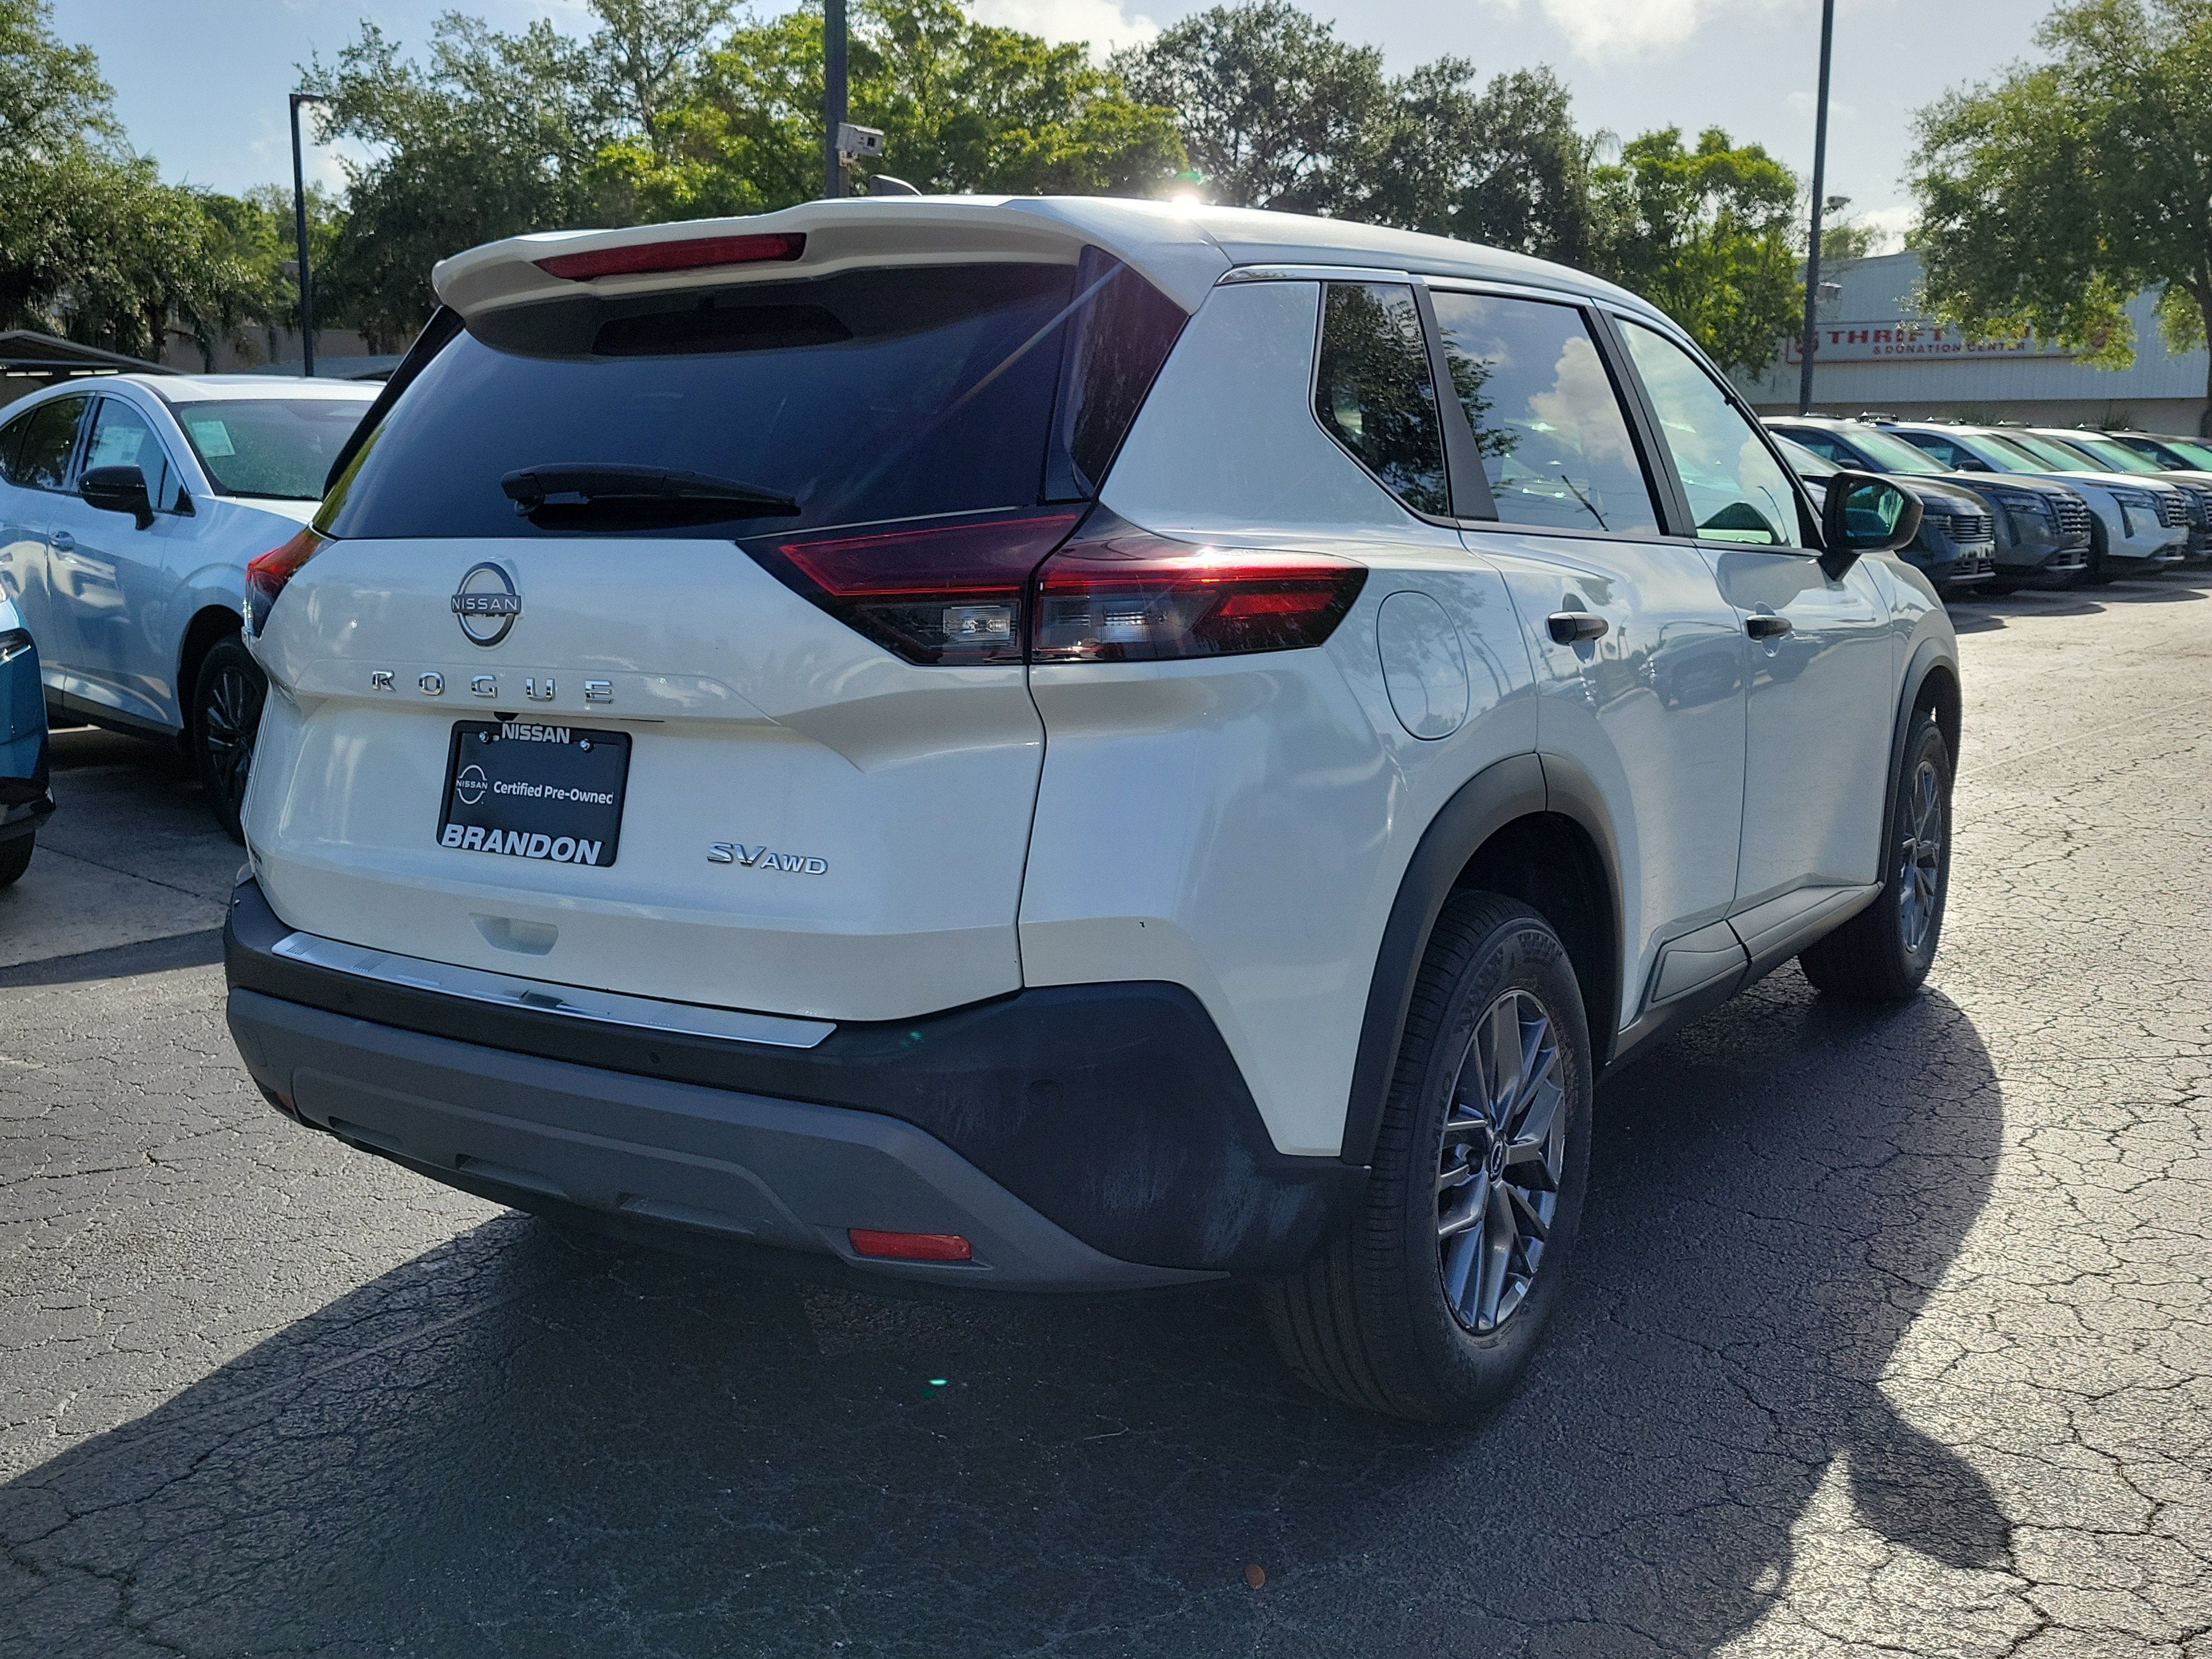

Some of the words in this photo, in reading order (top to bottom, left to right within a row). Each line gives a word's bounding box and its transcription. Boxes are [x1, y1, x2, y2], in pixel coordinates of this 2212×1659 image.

[1827, 329, 1945, 343] THRIFT
[1874, 345, 1881, 354] &
[1884, 343, 1961, 354] DONATION
[452, 598, 517, 610] NISSAN
[372, 669, 614, 704] ROGUE
[501, 723, 570, 744] NISSAN
[456, 780, 488, 790] NISSAN
[494, 781, 542, 797] Certified
[544, 786, 614, 804] Pre-Owned
[441, 823, 602, 865] BRANDON
